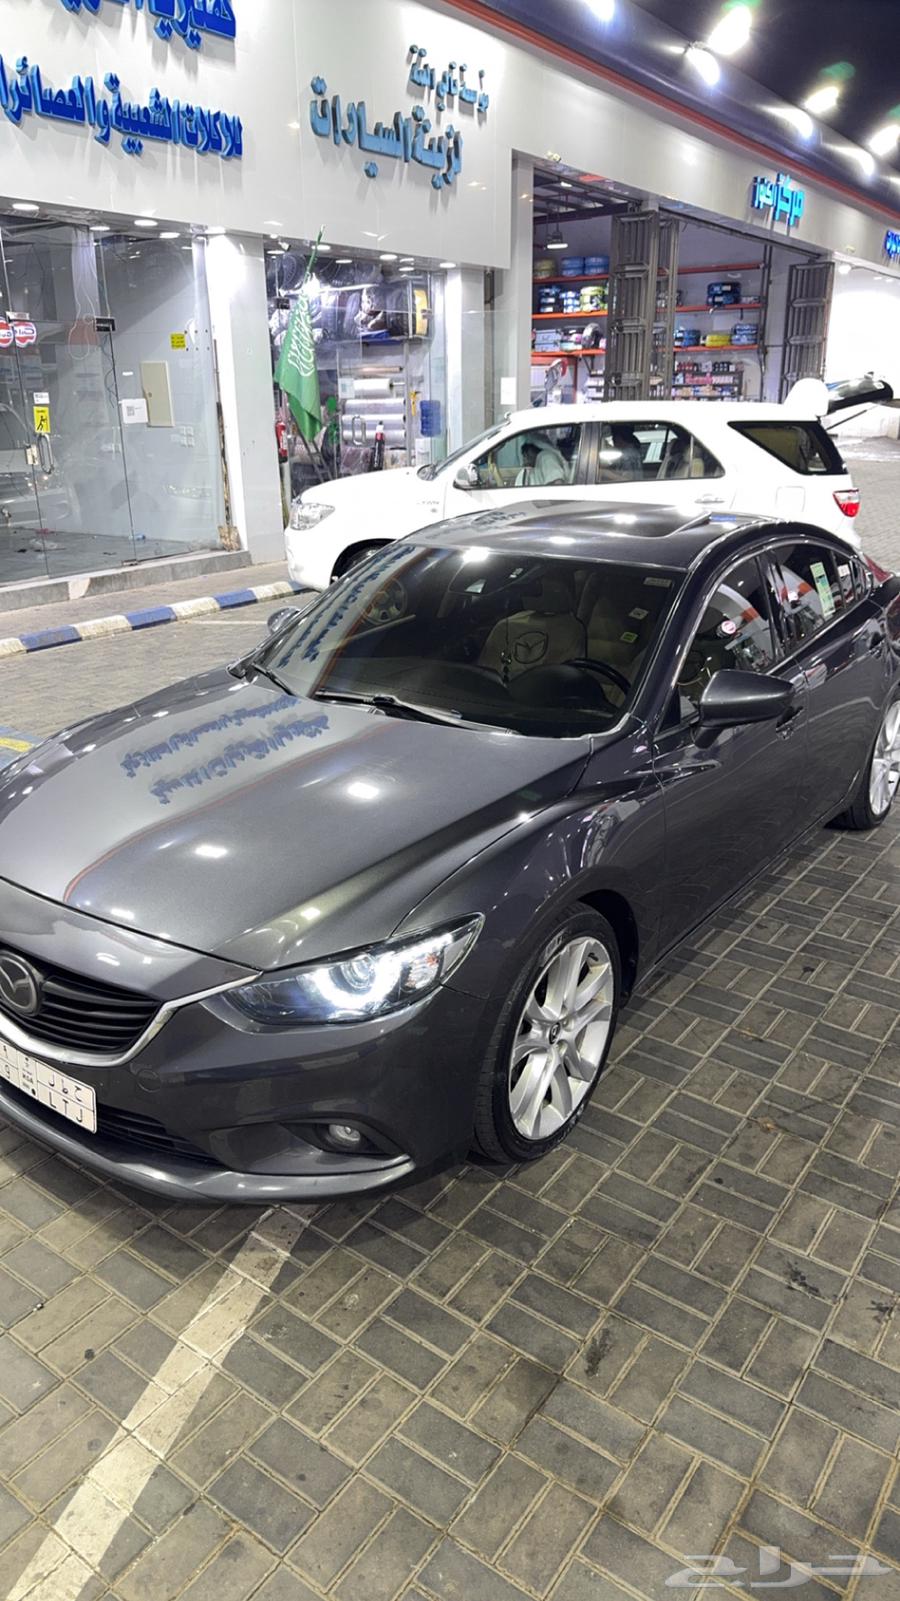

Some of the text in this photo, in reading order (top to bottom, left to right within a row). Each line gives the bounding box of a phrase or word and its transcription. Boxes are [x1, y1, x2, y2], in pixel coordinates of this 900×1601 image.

[4, 56, 112, 146] والعصائر
[104, 72, 180, 156] الشعبية
[310, 76, 463, 190] لزينة السيارات
[773, 172, 805, 227] مركز
